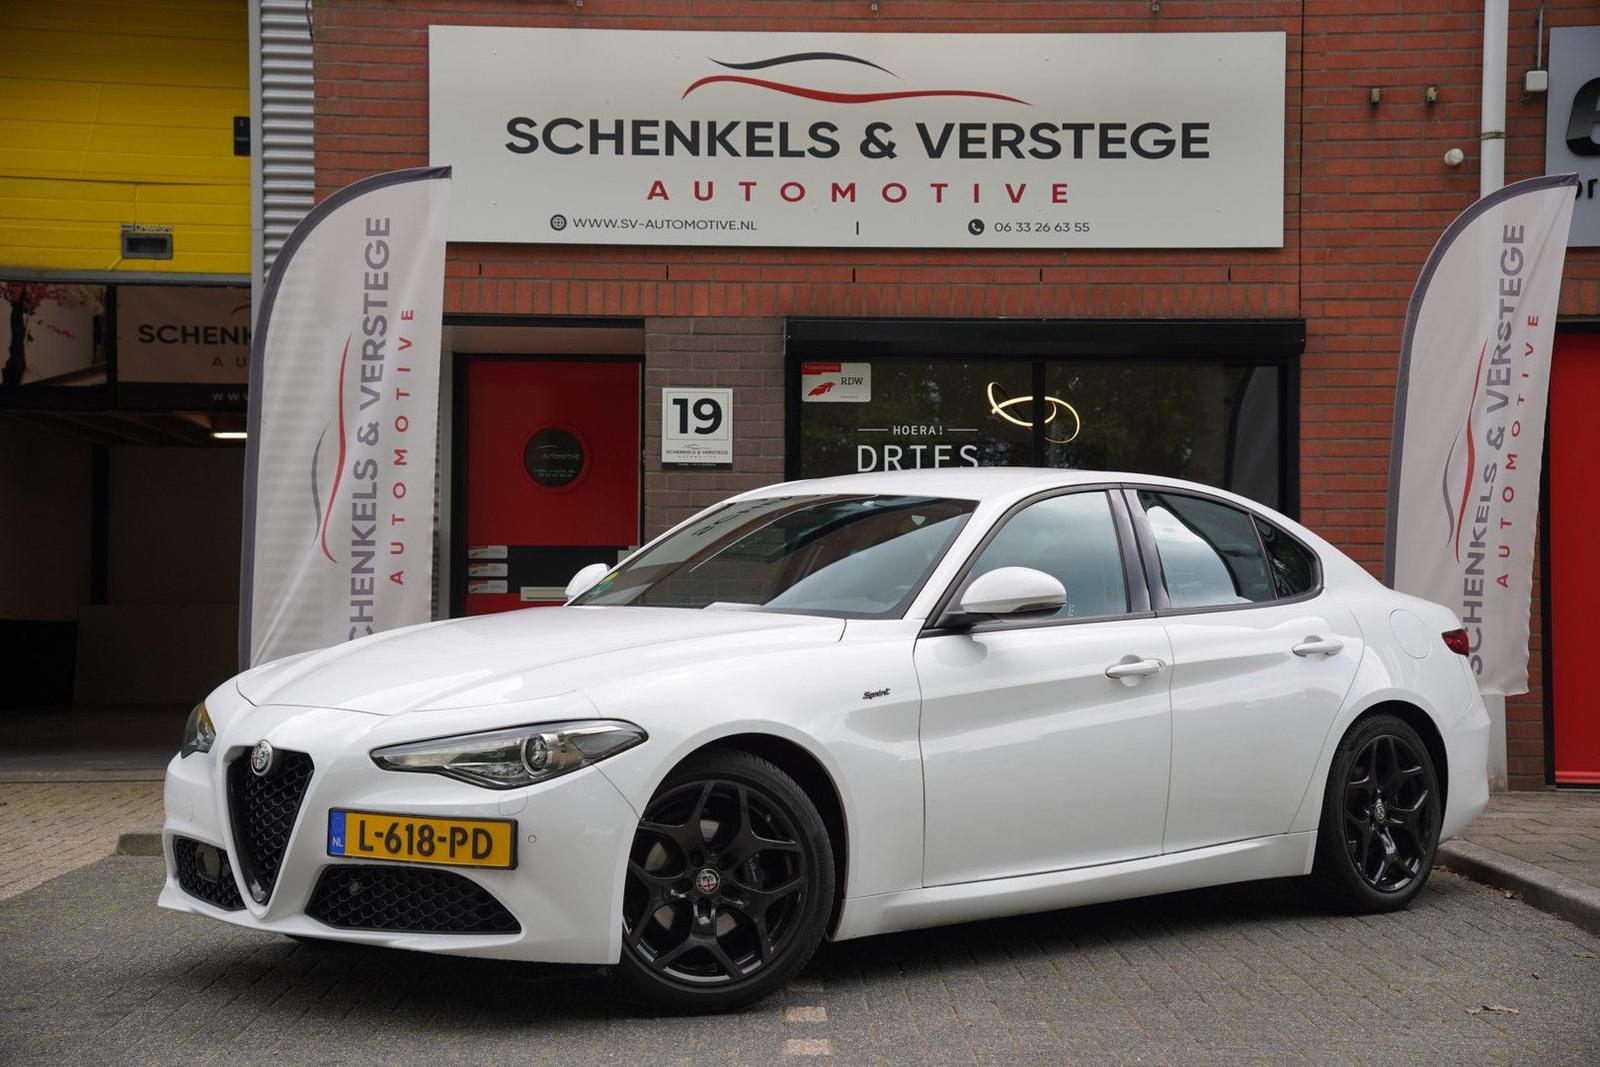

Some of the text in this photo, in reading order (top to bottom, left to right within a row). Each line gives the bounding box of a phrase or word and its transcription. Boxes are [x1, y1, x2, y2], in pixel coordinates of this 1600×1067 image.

[505, 116, 1210, 160] SCHENKELS & VERSTEGE
[646, 180, 1069, 203] AUTOMOTIVE
[572, 218, 758, 230] WWW.SV-AUTOMOTIVE.NL
[994, 222, 1090, 232] 06 33 26 63 55
[360, 218, 391, 411] VERSTEGE
[840, 377, 863, 386] RDW
[672, 398, 722, 434] 19
[357, 421, 379, 446] &
[893, 425, 943, 435] HOERA!
[390, 309, 414, 585] AUTOMOTIVE
[1462, 224, 1525, 676] SCHENKELS & VERSTEGE
[1496, 315, 1539, 589] AUTOMOTIVE
[862, 688, 891, 700] Sprint
[332, 837, 344, 847] NL
[358, 820, 493, 860] L-618-PD
